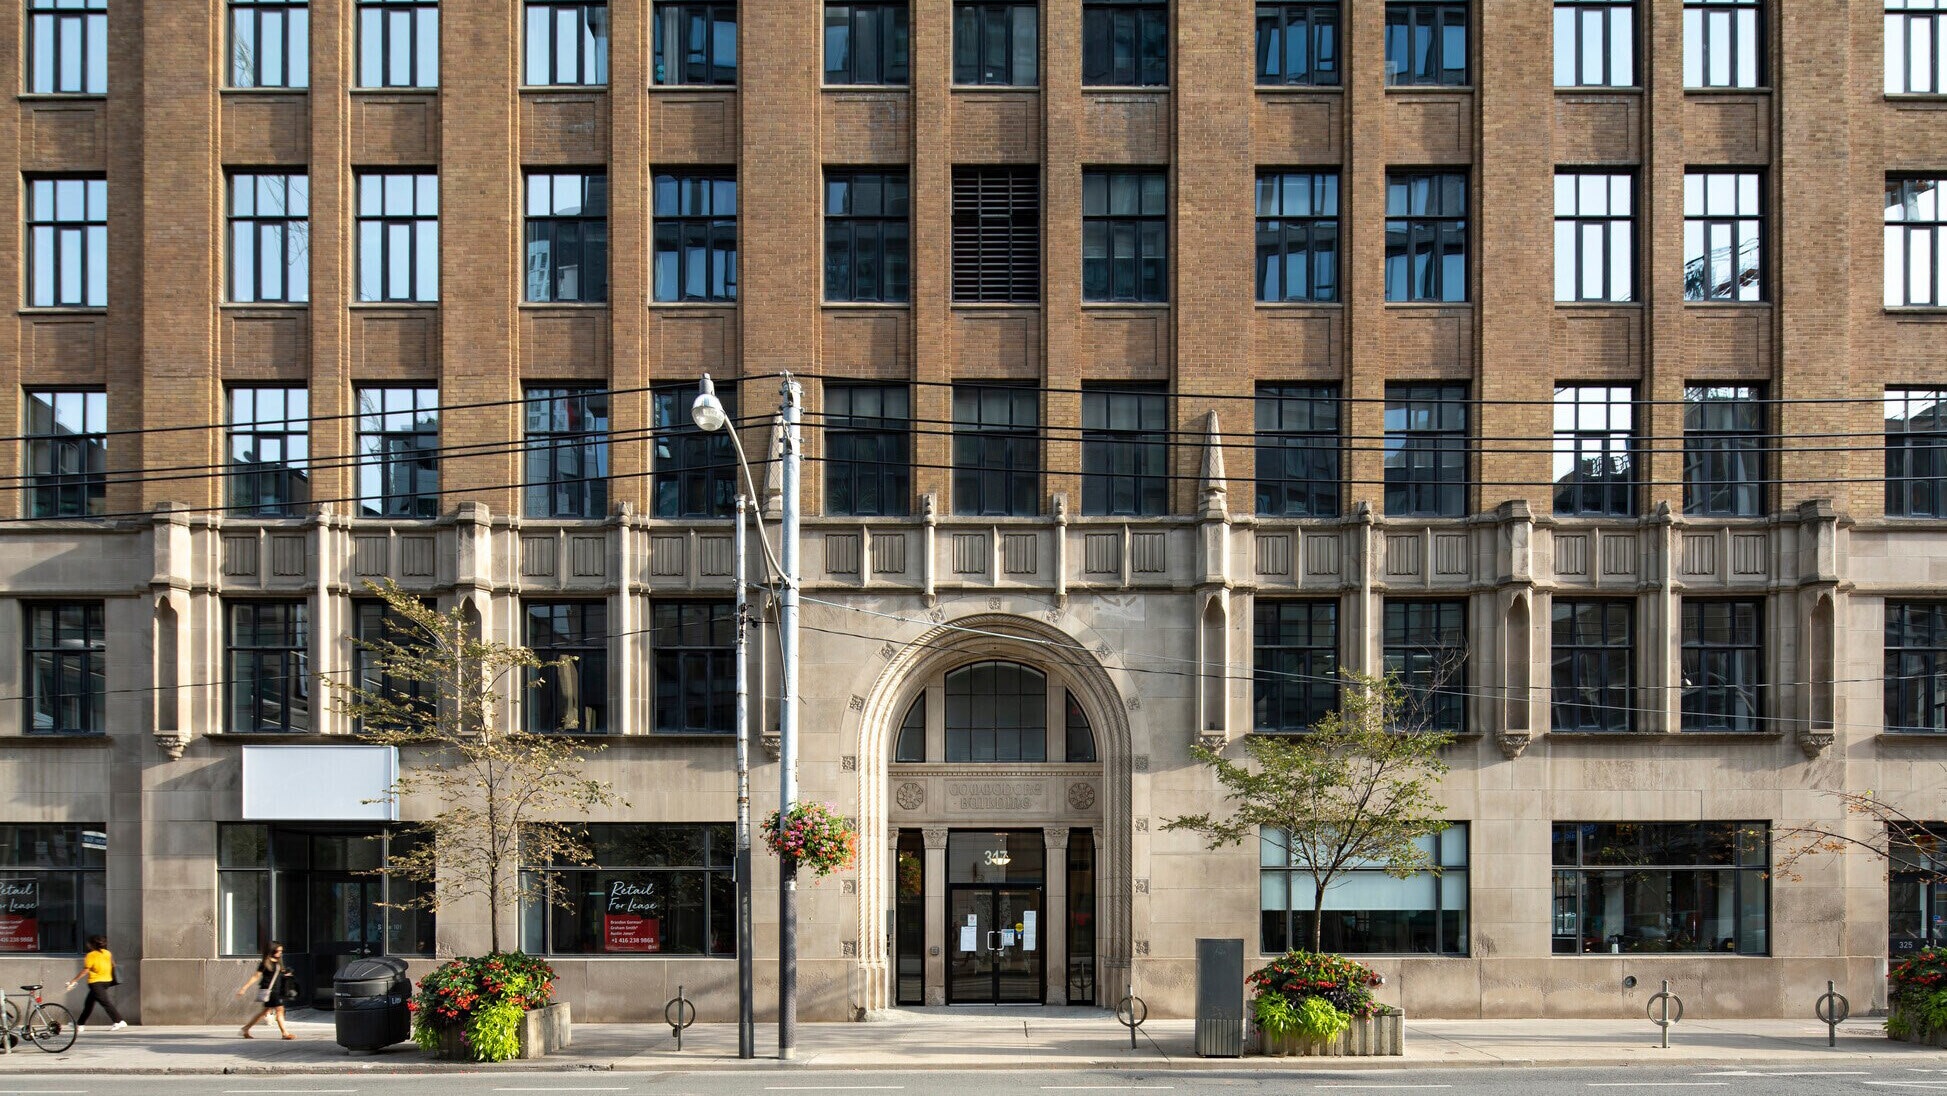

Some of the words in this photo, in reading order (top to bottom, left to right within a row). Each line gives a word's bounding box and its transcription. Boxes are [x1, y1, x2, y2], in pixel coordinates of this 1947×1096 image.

[960, 797, 1031, 810] BUILDING
[611, 881, 654, 897] Retail
[608, 897, 626, 911] For
[627, 898, 657, 912] Lease
